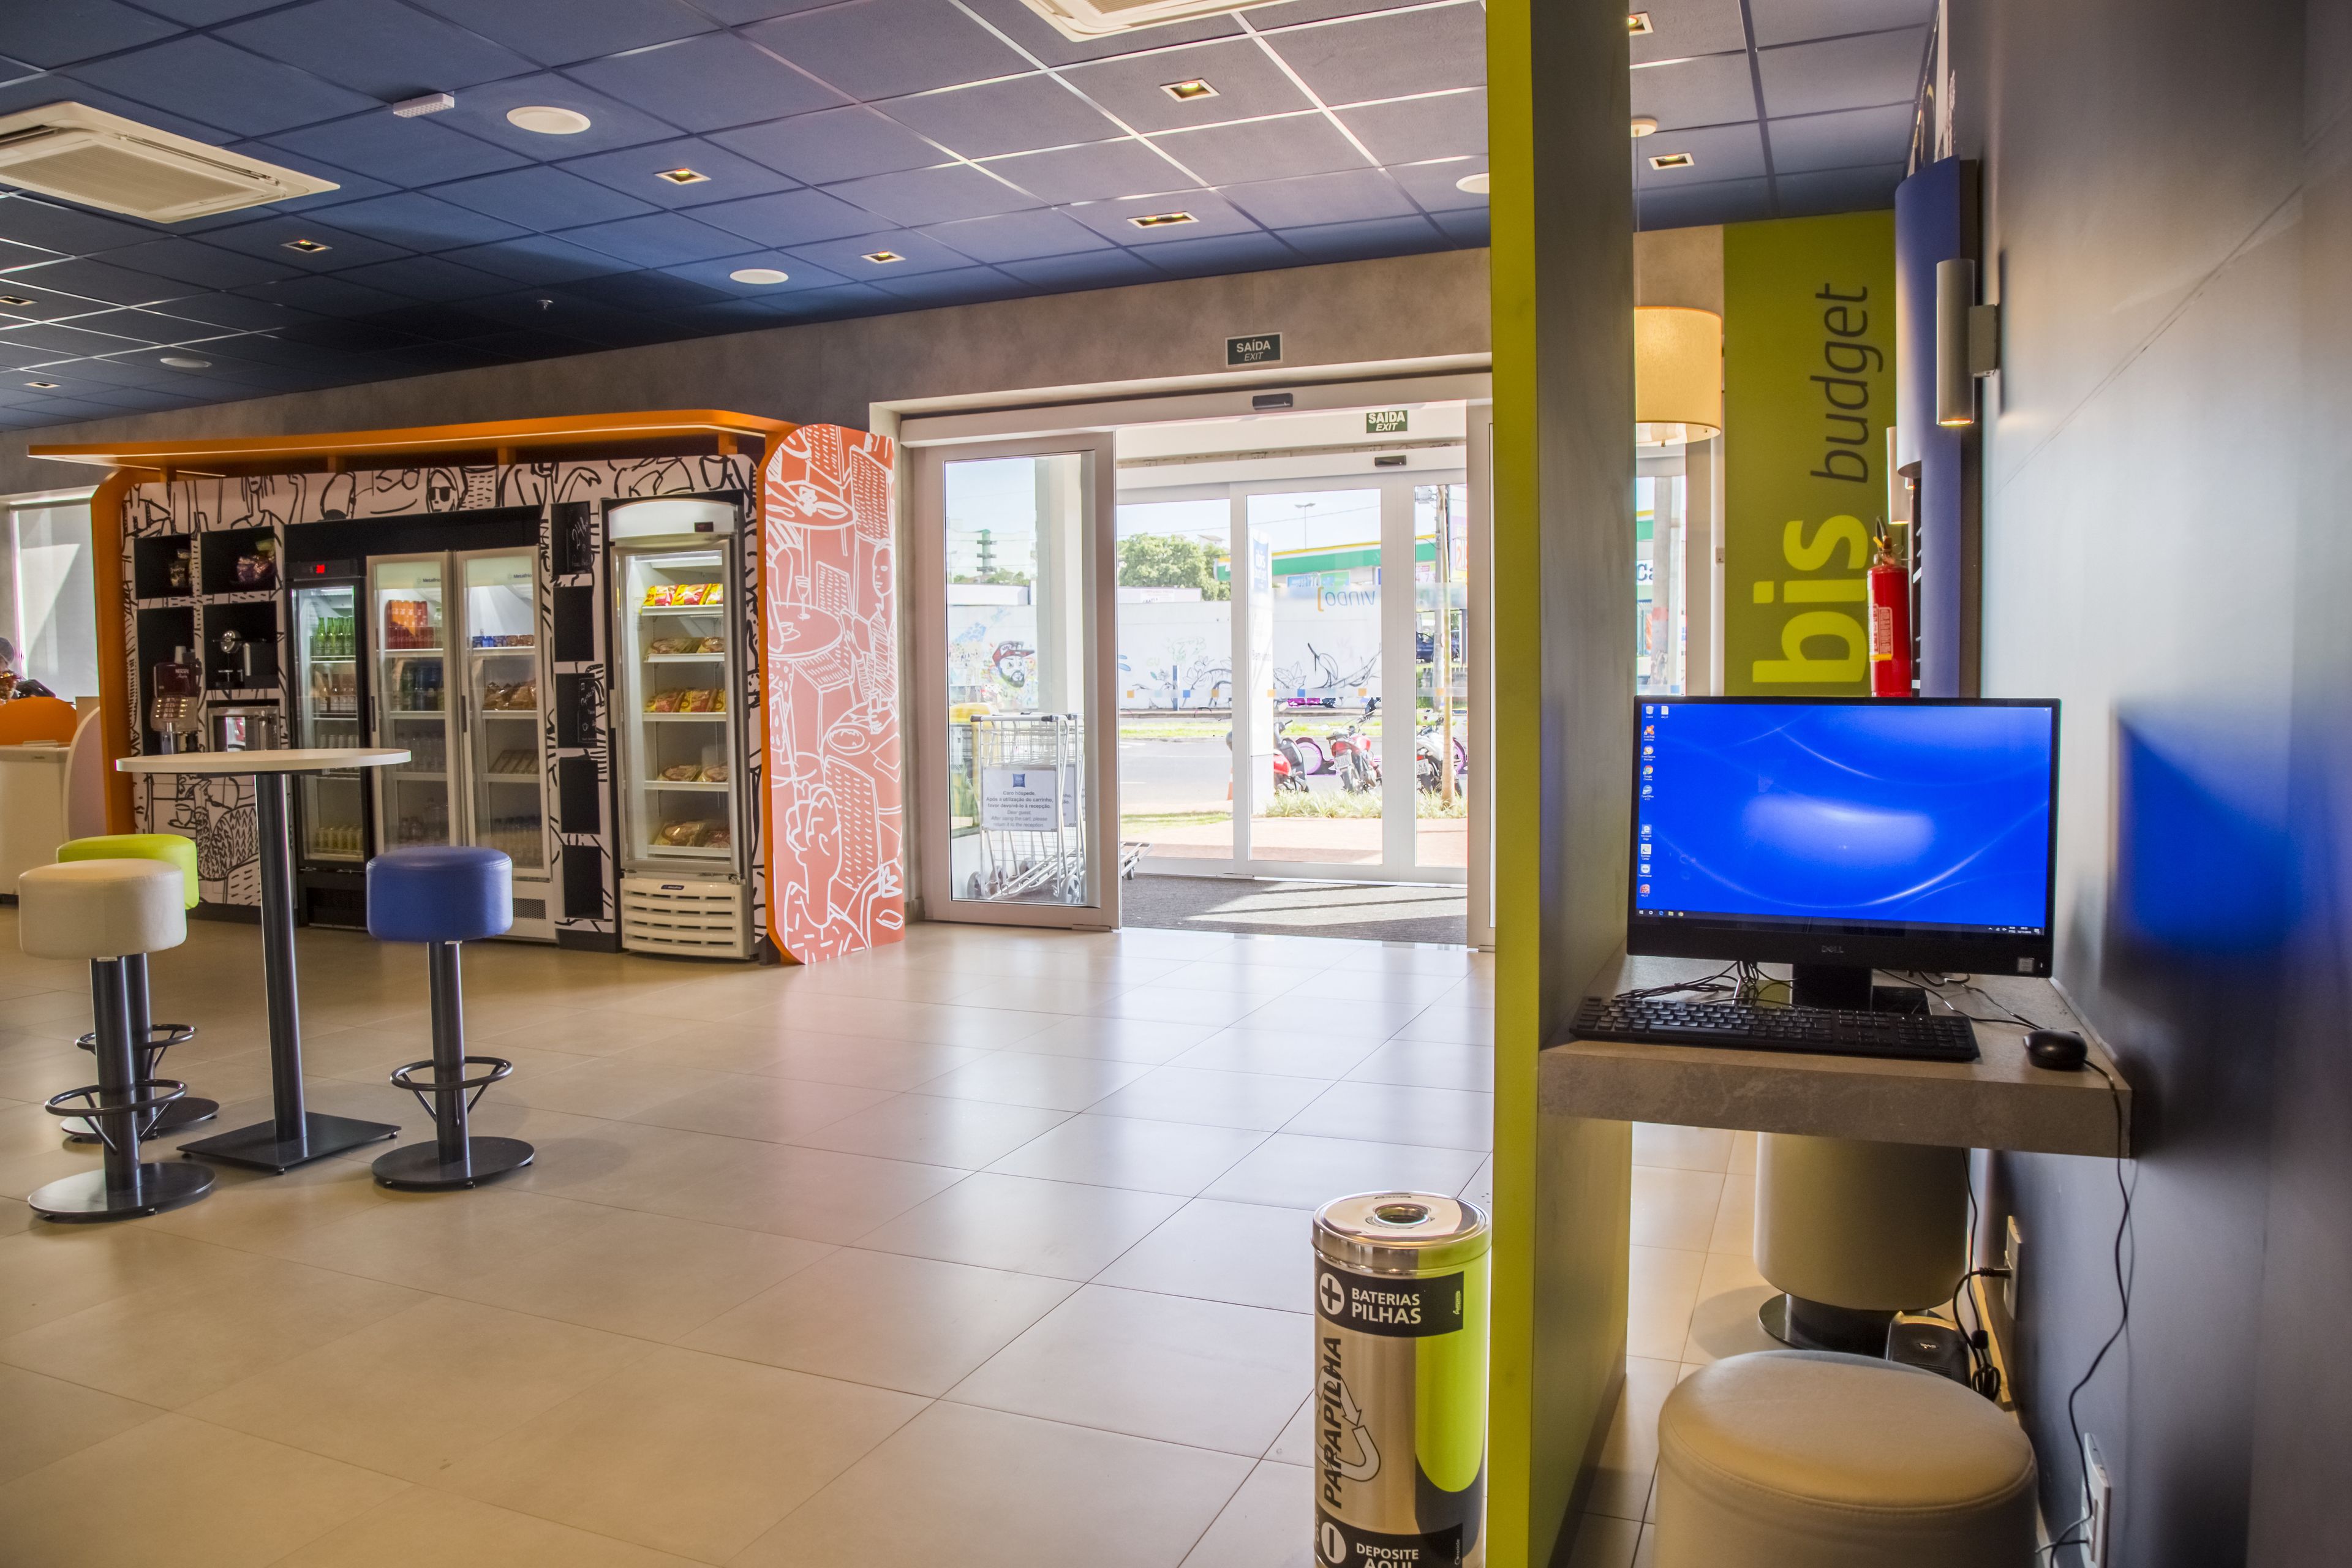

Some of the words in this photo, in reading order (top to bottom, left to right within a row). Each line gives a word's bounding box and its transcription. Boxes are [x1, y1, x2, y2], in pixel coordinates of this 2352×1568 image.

[1236, 339, 1271, 353] SAÍDA
[1244, 352, 1264, 361] EXIT
[1809, 283, 1883, 483] budget
[1376, 423, 1398, 432] EXIT
[1752, 514, 1869, 683] bis
[1352, 1287, 1420, 1306] BATERIAS
[1352, 1302, 1422, 1324] PILHAS
[1323, 1337, 1342, 1509] PARAPILHA
[1356, 1542, 1419, 1561] DEPOSITE
